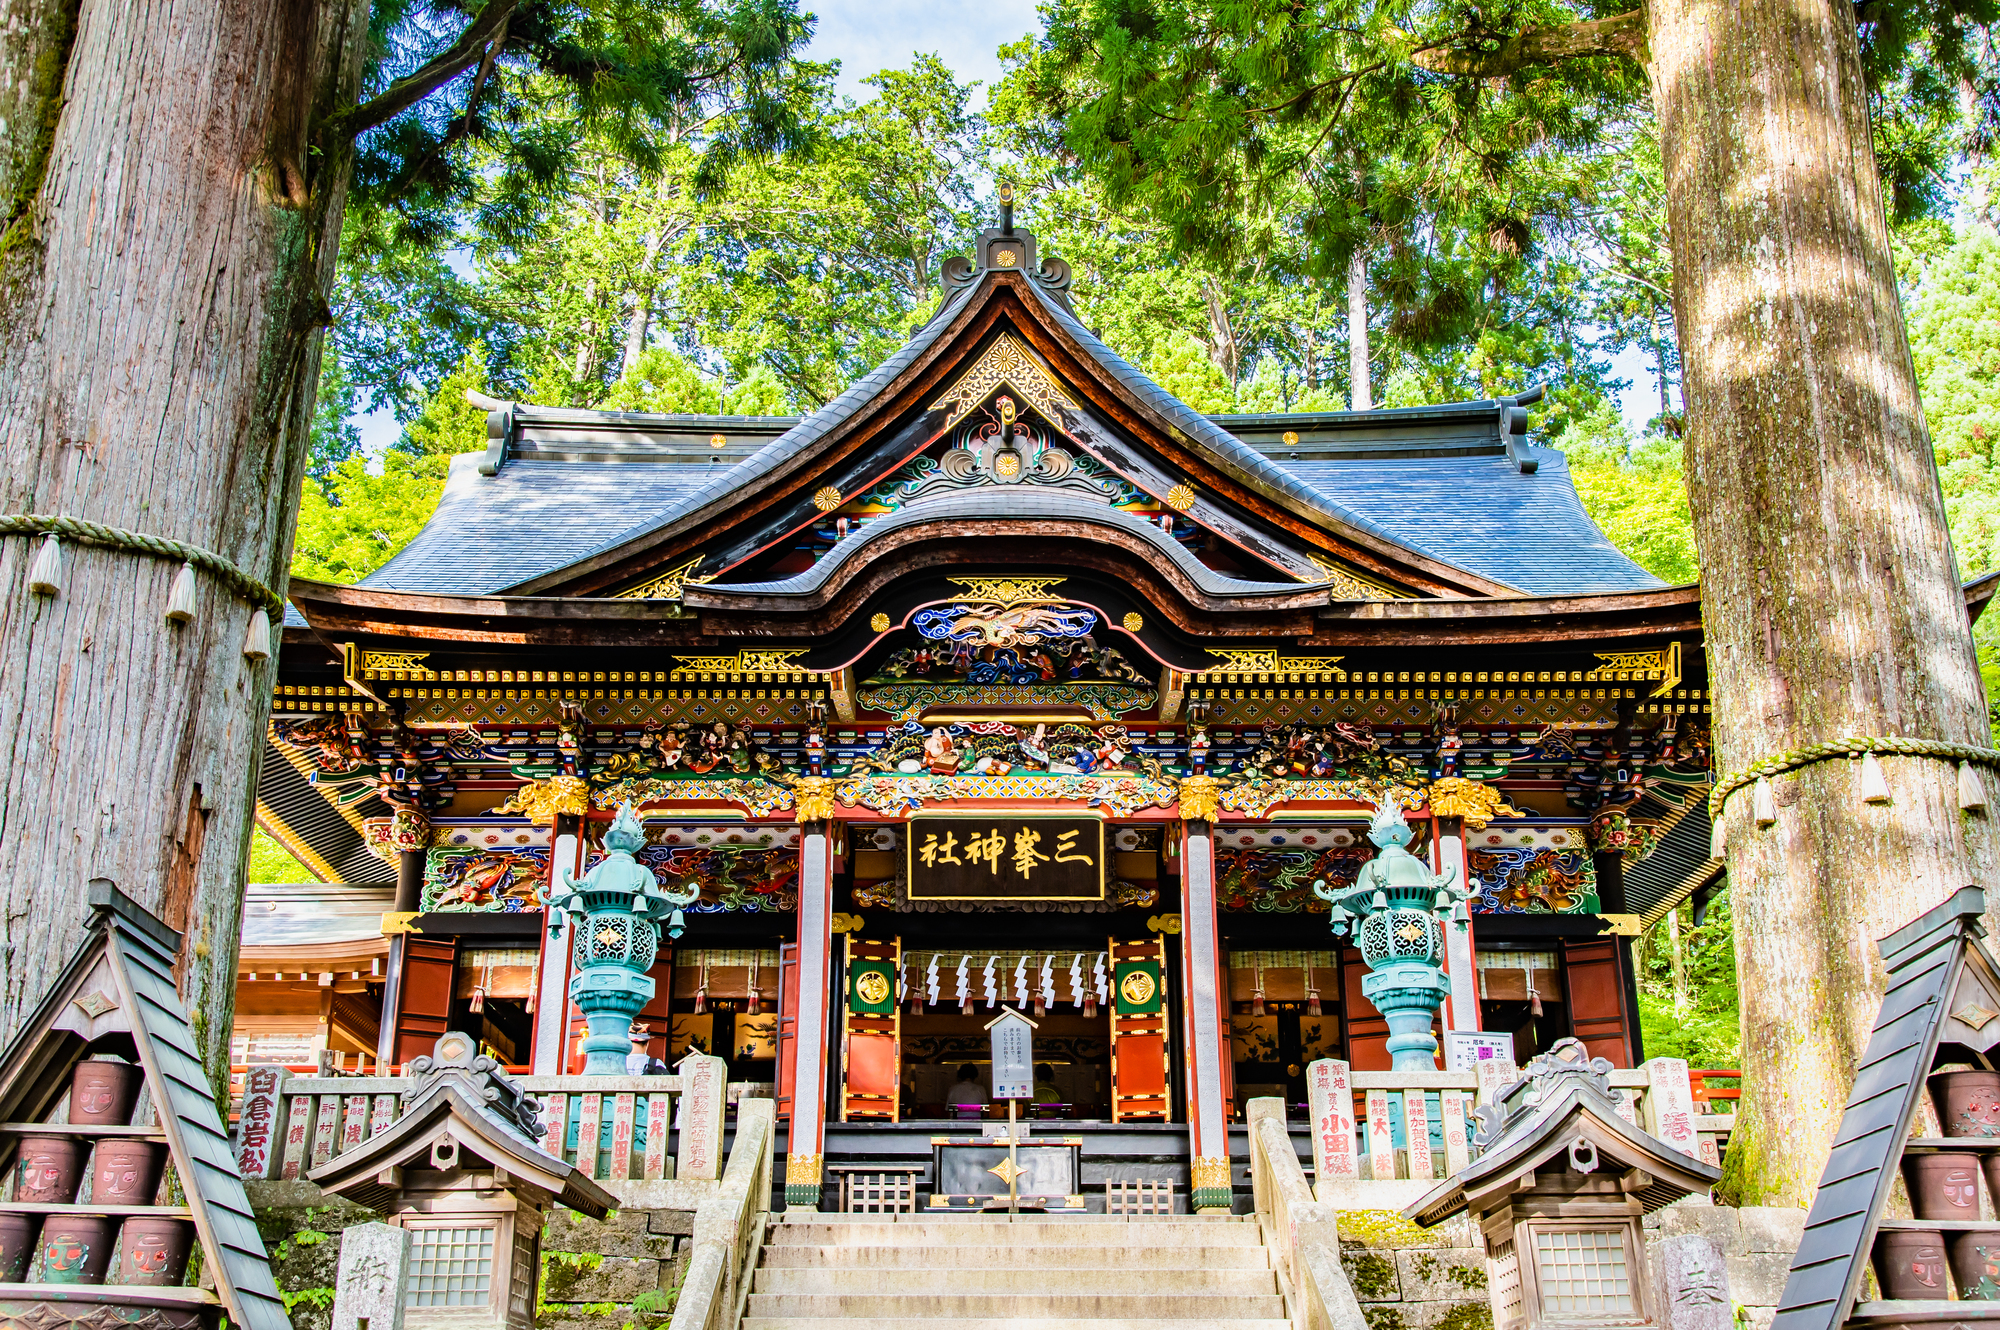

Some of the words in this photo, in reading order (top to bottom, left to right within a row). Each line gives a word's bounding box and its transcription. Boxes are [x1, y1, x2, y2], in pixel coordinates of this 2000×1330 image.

[919, 826, 1093, 879] 三峯神社
[238, 1068, 278, 1175] 臼倉岩松
[315, 1103, 336, 1167] 新村義
[1322, 1114, 1353, 1175] 小田磯
[1374, 1118, 1392, 1172] 大栄
[1410, 1117, 1430, 1171] 加賀銀次郎
[1675, 1261, 1725, 1307] 奉
